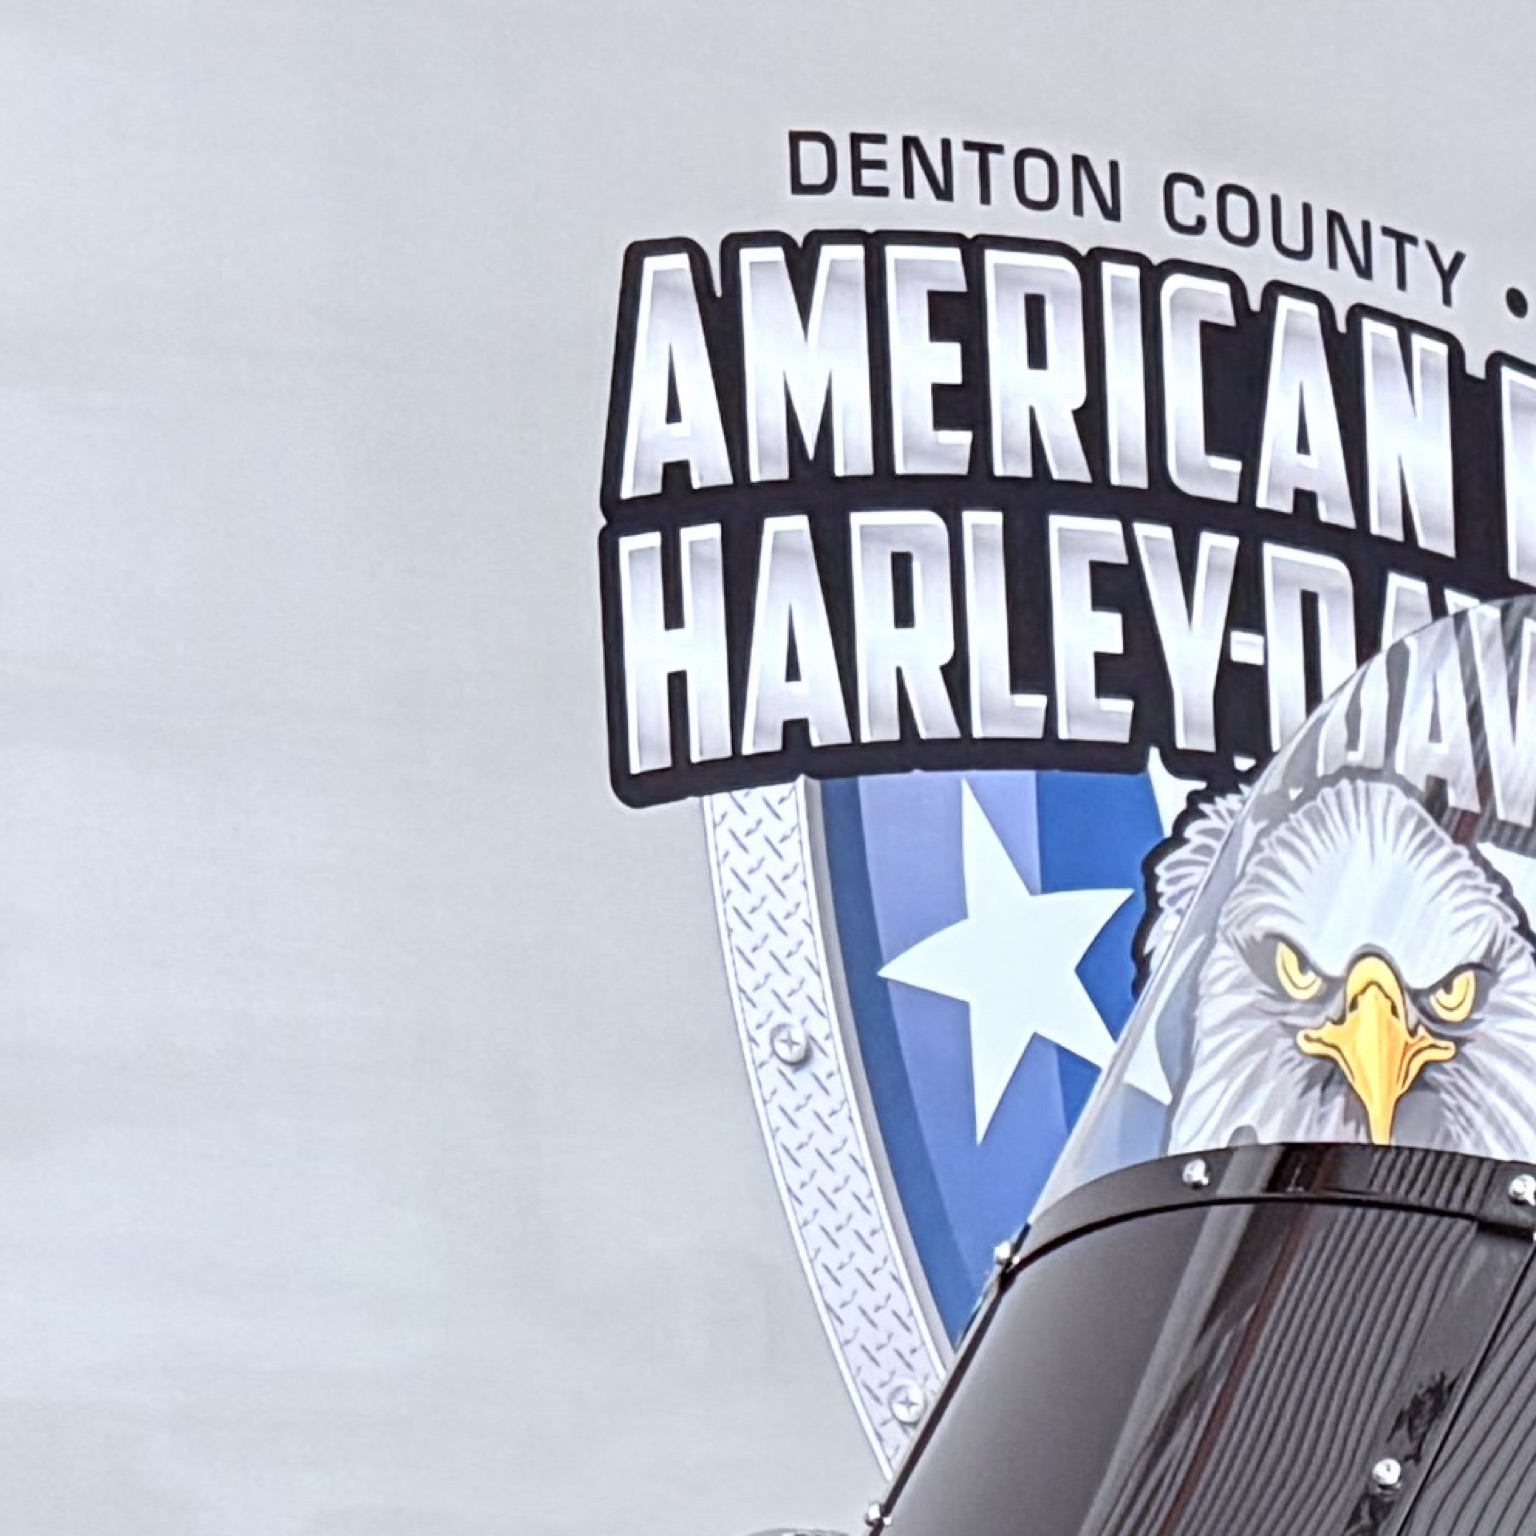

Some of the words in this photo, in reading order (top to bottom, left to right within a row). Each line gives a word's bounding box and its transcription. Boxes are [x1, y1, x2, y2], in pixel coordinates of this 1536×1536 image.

[786, 128, 1125, 224] DENTON
[1161, 170, 1469, 306] COUNTY
[614, 240, 1462, 560] AMERICAN
